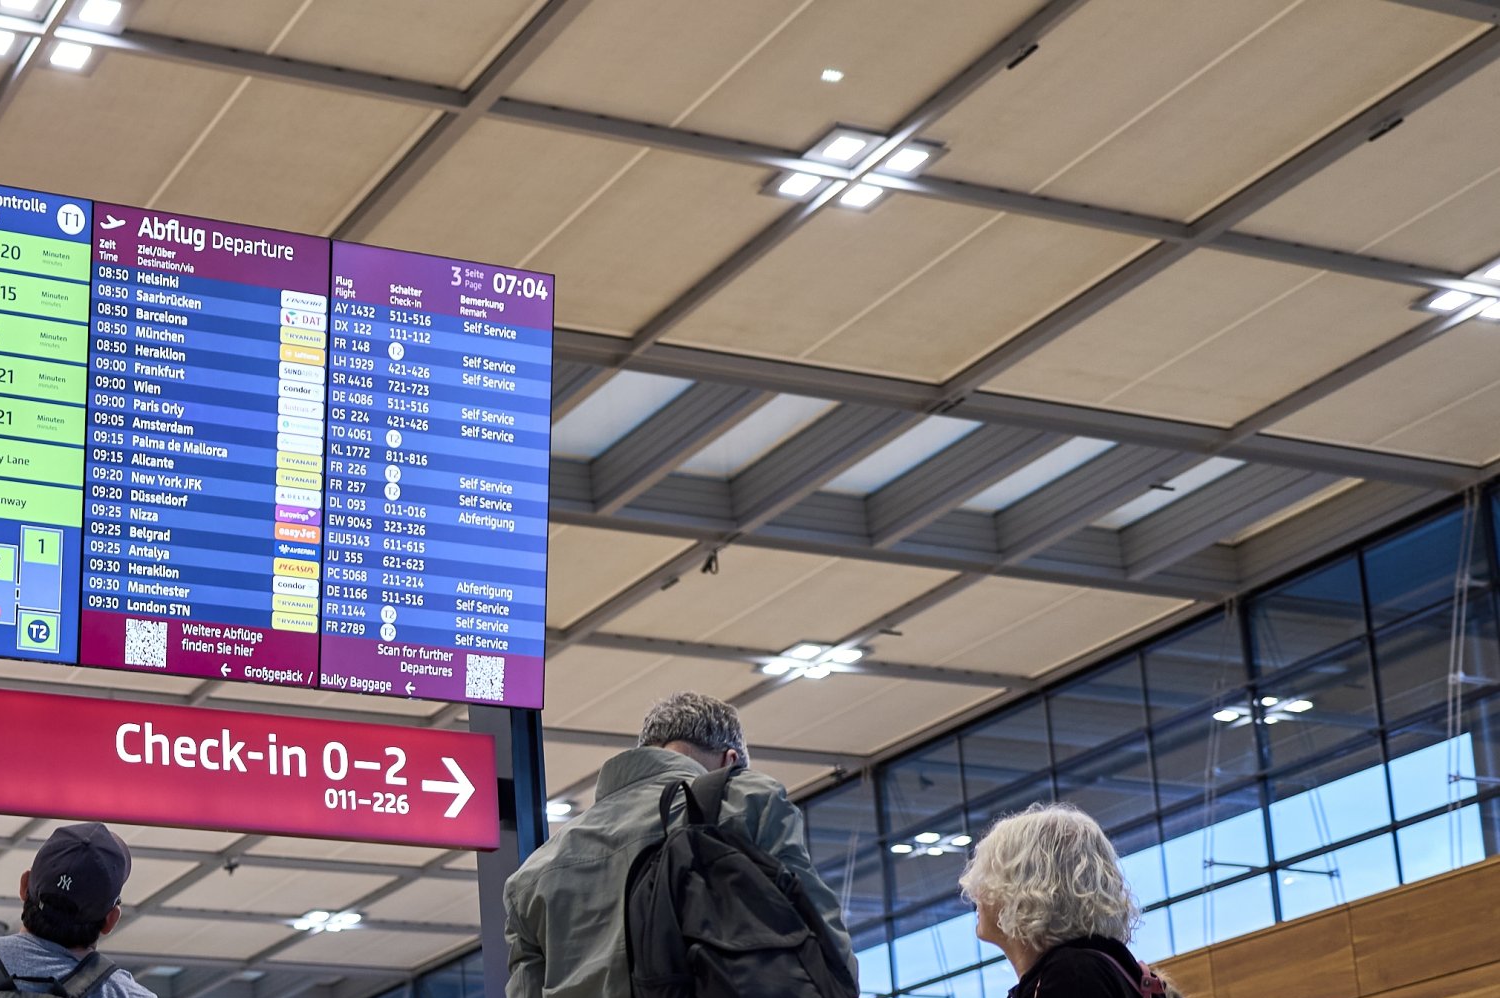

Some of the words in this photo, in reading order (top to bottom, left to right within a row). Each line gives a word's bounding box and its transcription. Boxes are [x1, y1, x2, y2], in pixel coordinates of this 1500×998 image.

[62, 211, 79, 227] T1
[137, 216, 205, 252] Abflug
[212, 231, 294, 261] Departure
[42, 250, 70, 260] Minuten
[451, 265, 462, 286] 3
[493, 272, 548, 300] 07:04
[98, 284, 128, 299] 08:50
[136, 289, 201, 310] Saarbrücken
[302, 315, 320, 326] DAT
[334, 302, 348, 314] AY
[351, 304, 375, 318] 1432
[389, 309, 431, 326] 511-516
[463, 321, 482, 334] Self
[483, 324, 516, 340] Service
[93, 430, 124, 445] 09:15
[132, 434, 165, 450] Palma
[167, 438, 181, 452] de
[183, 441, 228, 458] Mallorca
[7, 454, 30, 466] Lane
[92, 466, 123, 481] 09:20
[131, 471, 155, 485] New
[157, 474, 182, 488] York
[183, 477, 202, 491] JFK
[329, 496, 342, 508] DL
[346, 498, 366, 511] 093
[384, 502, 426, 518] 011-016
[458, 512, 515, 532] Abfertigung
[277, 581, 305, 589] condor
[88, 595, 119, 609] 09:30
[127, 598, 167, 614] London
[169, 603, 190, 616] STN
[181, 623, 221, 638] Weitere
[222, 627, 263, 644] Abflüge
[181, 637, 214, 653] finden
[216, 642, 232, 655] Sie
[233, 643, 254, 657] hier
[377, 643, 400, 656] Scan
[402, 645, 417, 658] for
[418, 647, 453, 662] further
[244, 665, 303, 682] Großgepäck
[320, 673, 348, 689] Bulky
[349, 676, 392, 693] Baggage
[400, 661, 453, 677] Departures
[117, 723, 306, 776] Check-in
[57, 874, 73, 891] NY
